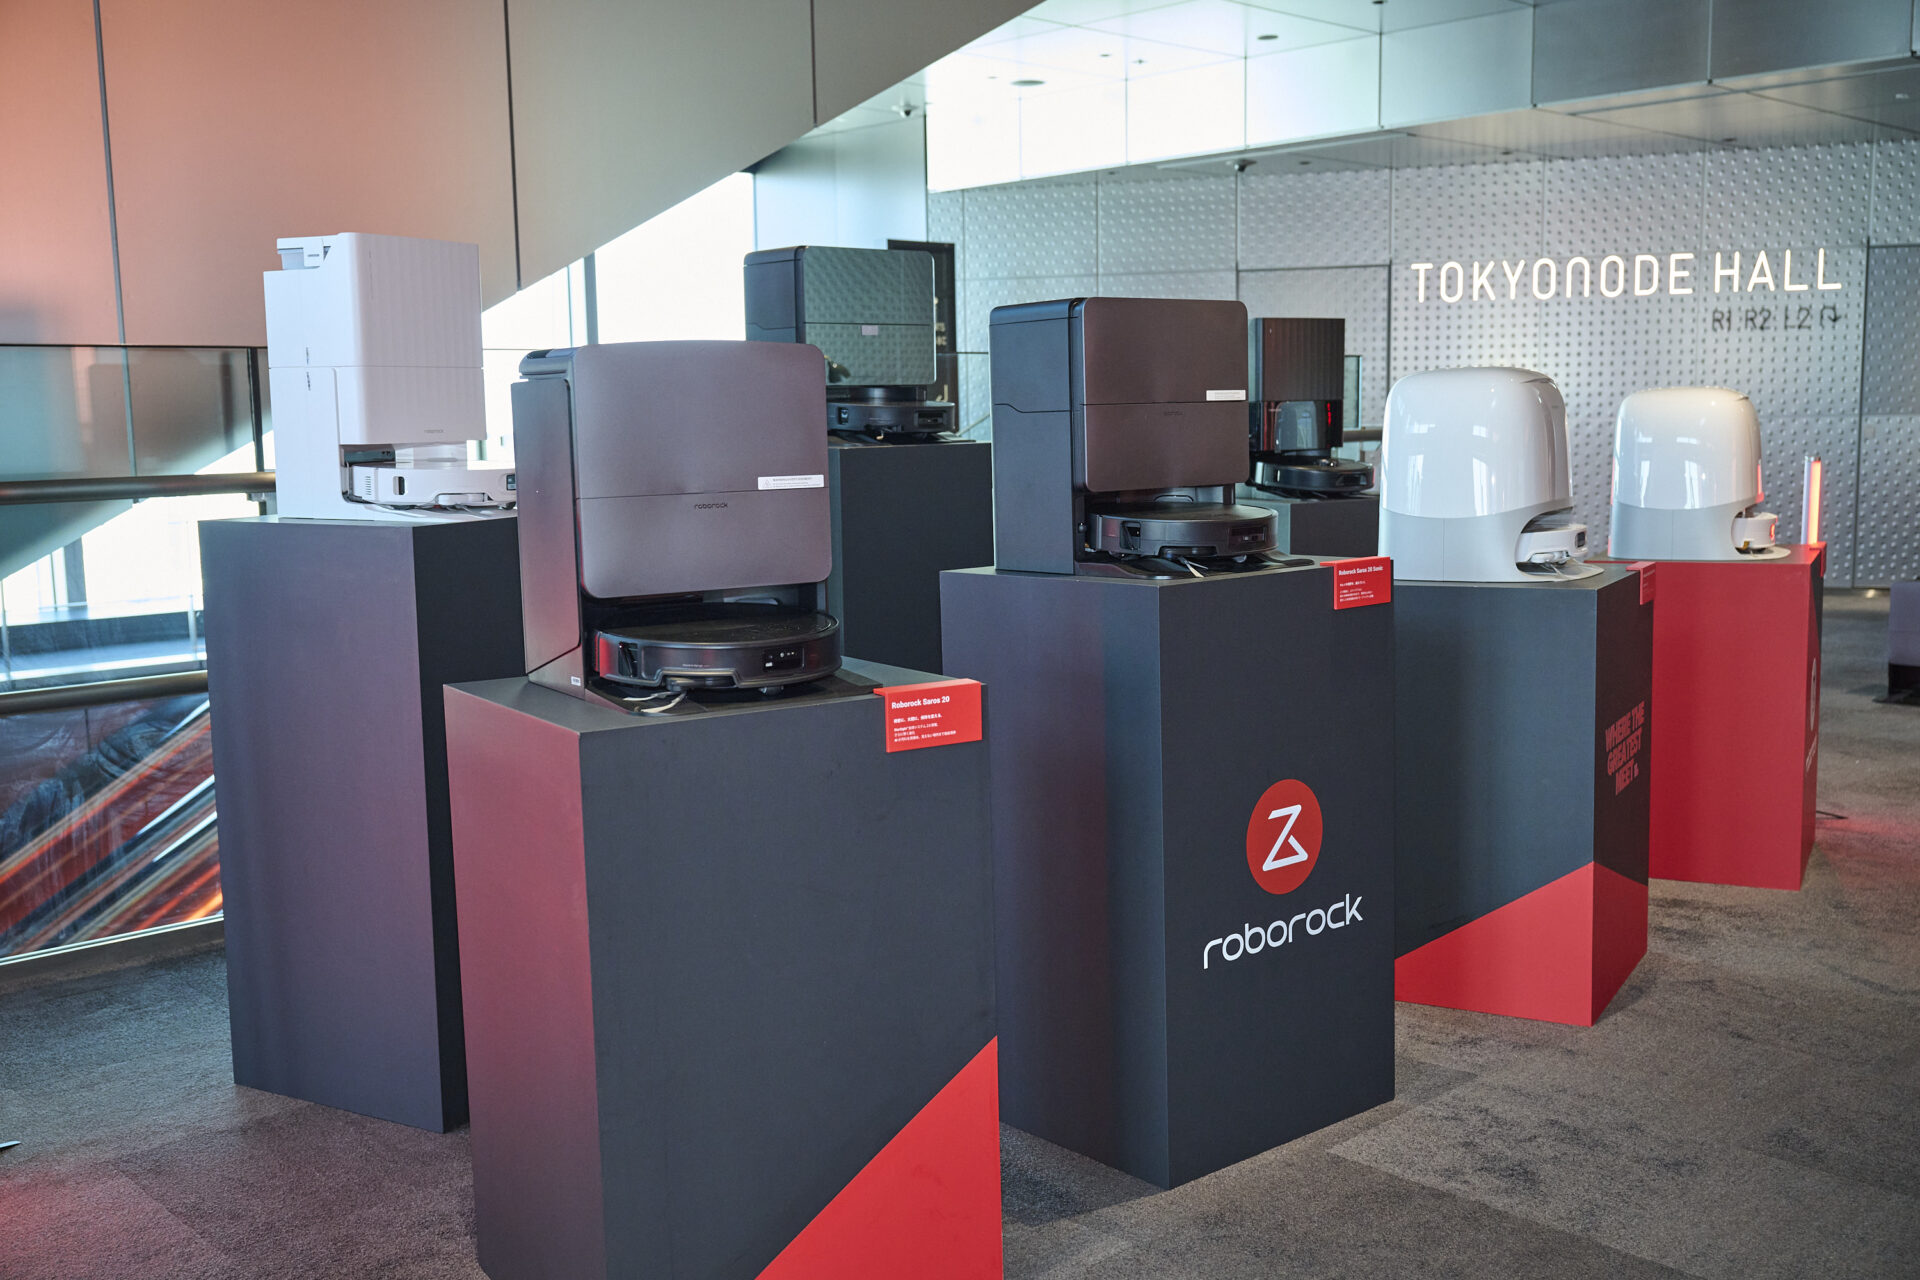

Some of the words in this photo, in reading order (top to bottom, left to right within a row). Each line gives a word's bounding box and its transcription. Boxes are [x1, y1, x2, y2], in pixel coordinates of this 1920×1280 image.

[1714, 248, 1842, 293] HALL
[1712, 307, 1732, 332] R1
[1744, 307, 1772, 331] R2
[1784, 304, 1812, 331] L2
[891, 699, 922, 709] Roborock
[922, 697, 940, 705] Saros
[941, 695, 950, 703] 20
[1605, 711, 1631, 752] WHERE
[1631, 700, 1645, 731] THE
[1607, 726, 1642, 776] GREATEST
[1203, 893, 1363, 970] roborock
